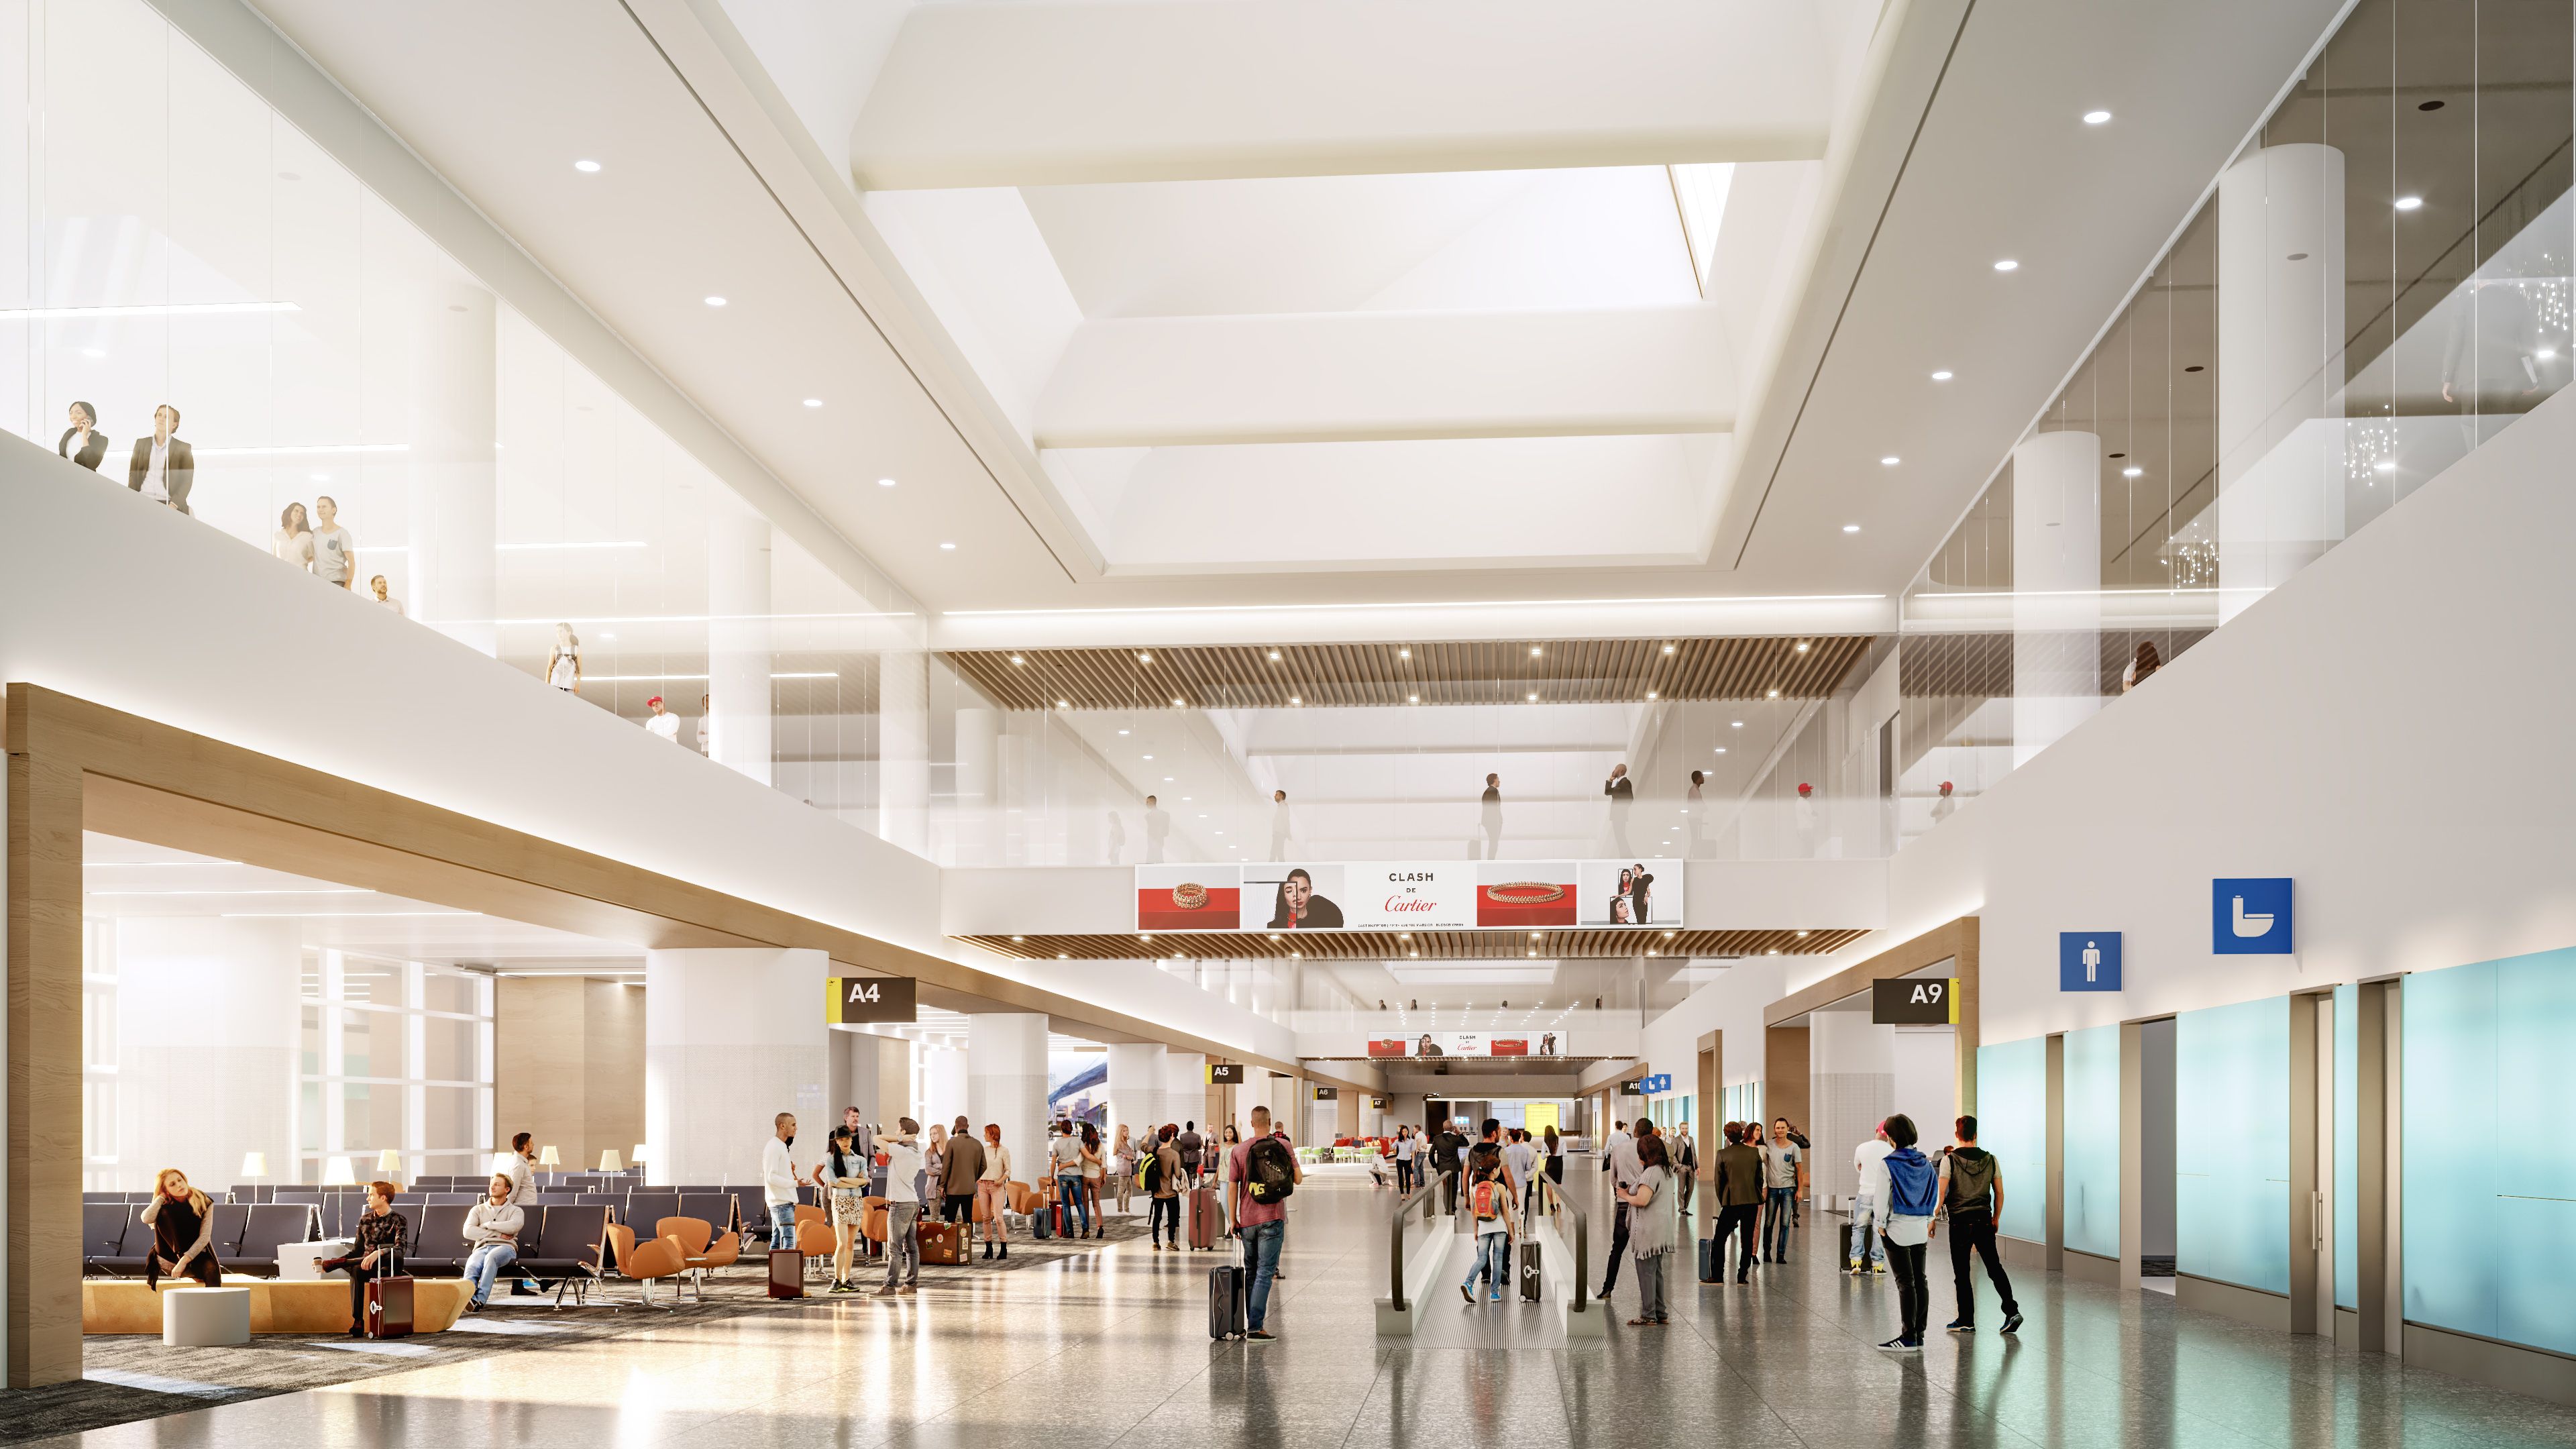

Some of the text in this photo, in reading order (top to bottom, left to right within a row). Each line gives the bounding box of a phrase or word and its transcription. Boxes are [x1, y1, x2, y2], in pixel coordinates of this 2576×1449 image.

[1389, 873, 1434, 882] CLASH
[1385, 895, 1437, 912] Cartier
[848, 983, 881, 1003] A4
[1910, 983, 1943, 1004] A9
[1214, 1067, 1229, 1076] A5
